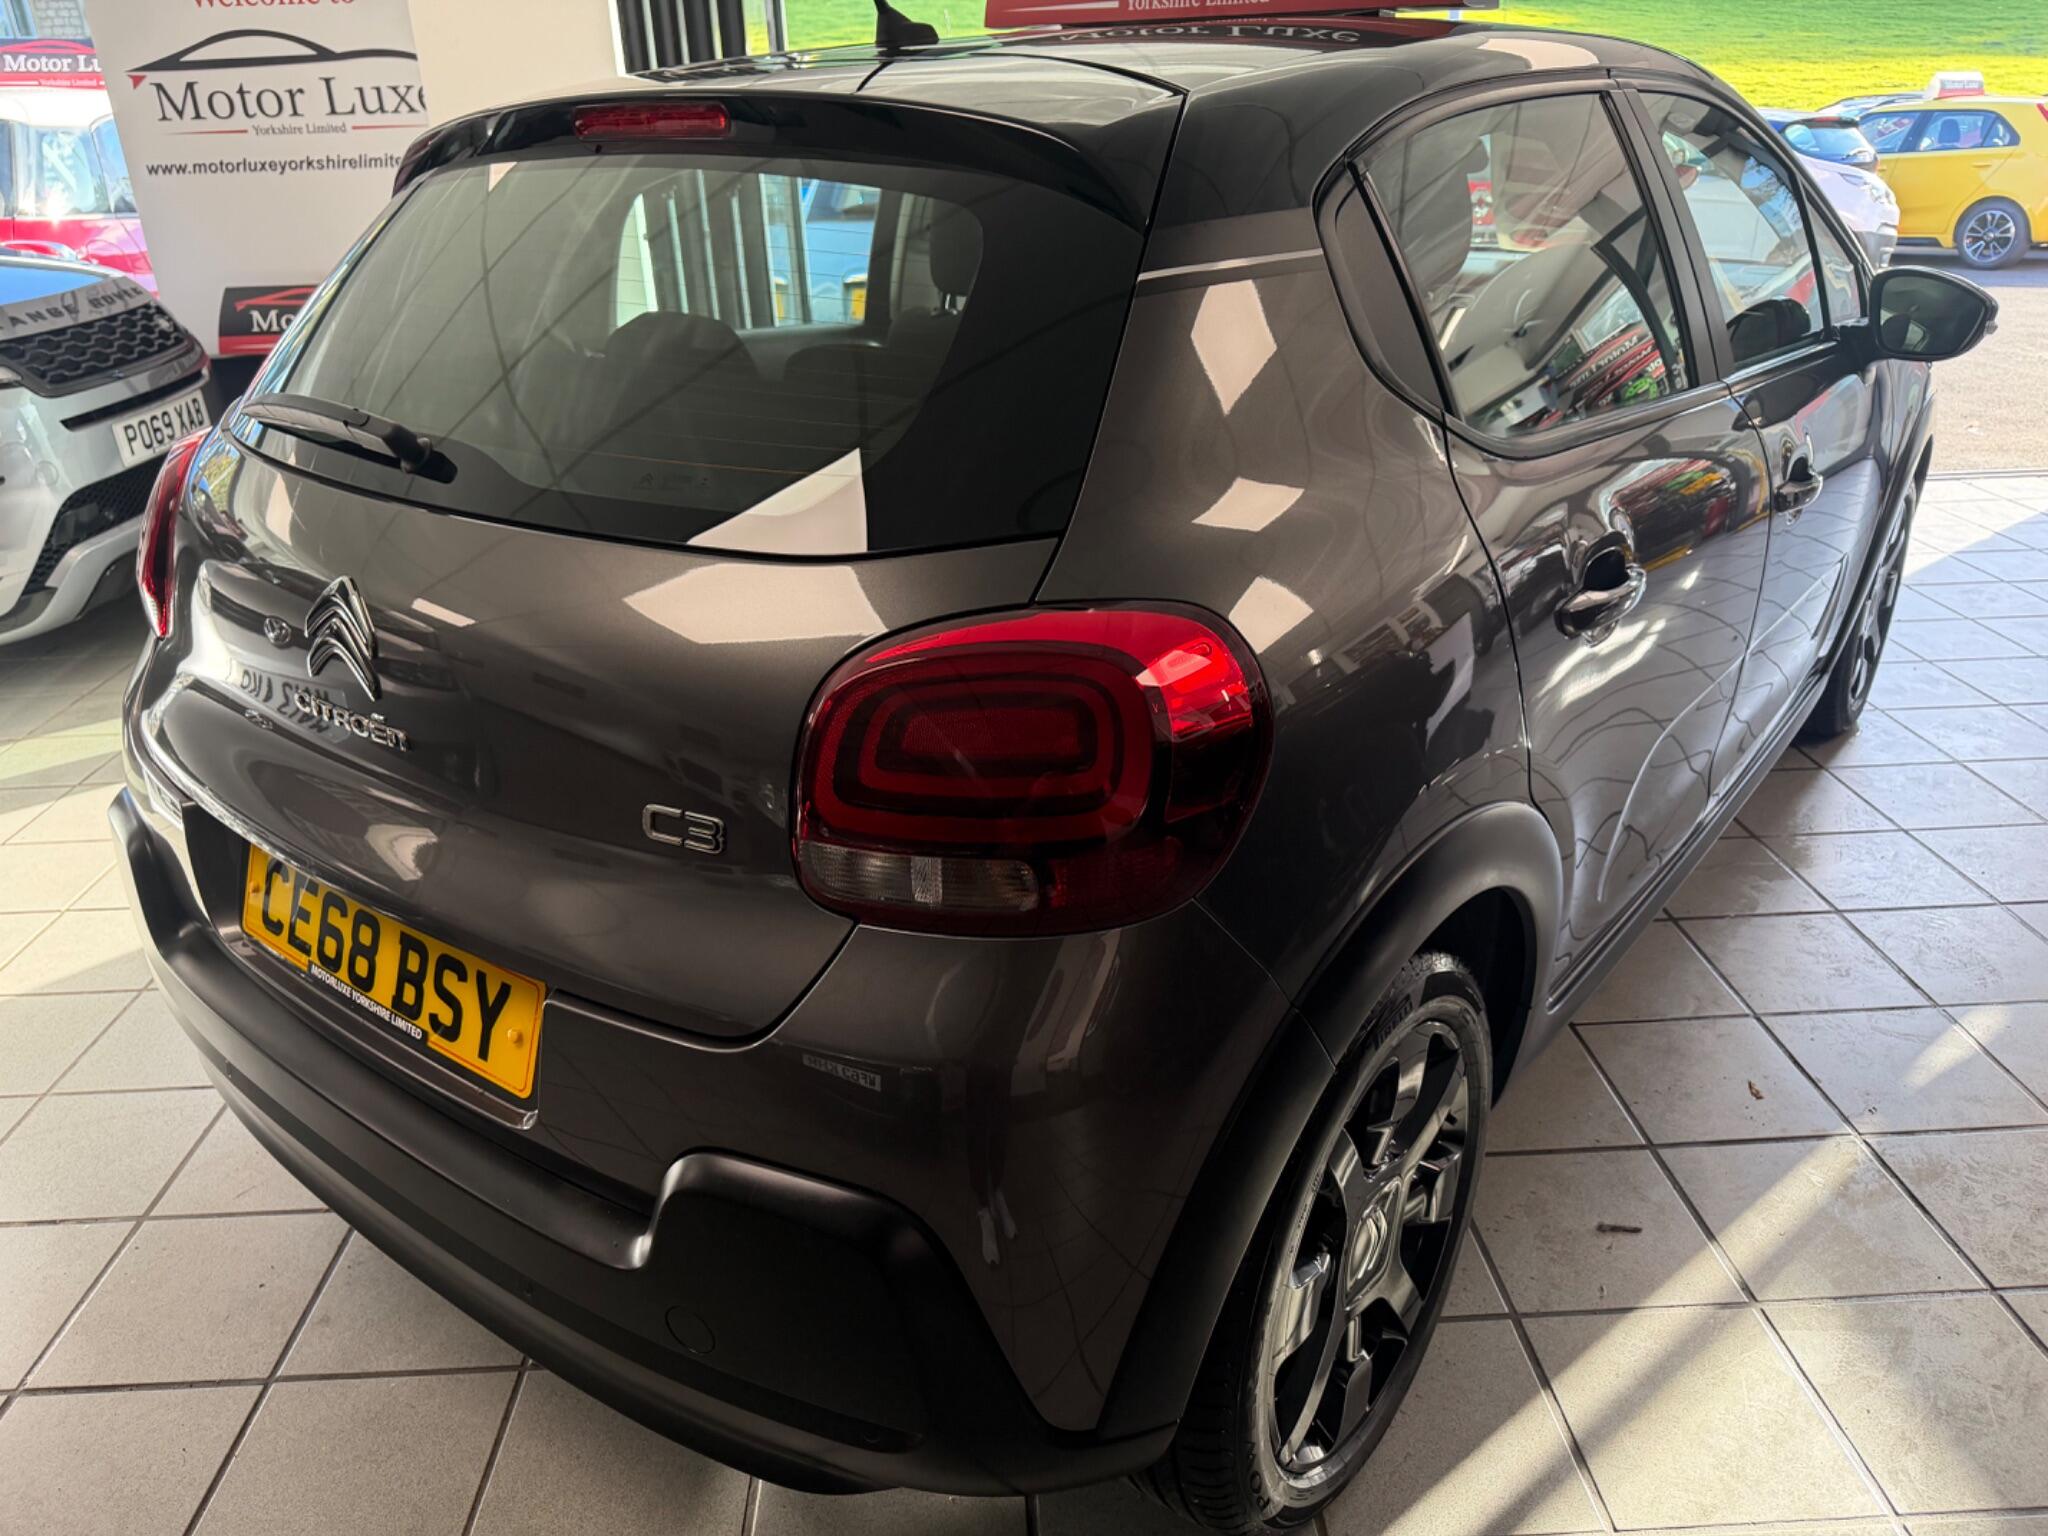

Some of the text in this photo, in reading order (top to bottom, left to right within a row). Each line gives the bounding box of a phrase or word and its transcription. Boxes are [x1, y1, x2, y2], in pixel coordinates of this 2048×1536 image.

[2, 54, 73, 72] Motor
[149, 80, 305, 122] Motor
[251, 121, 348, 136] Yorkshire Limited
[0, 302, 80, 331] ANGE
[123, 397, 205, 456] PO69 XAB
[294, 689, 408, 752] CITROËN
[642, 803, 725, 855] C3
[261, 858, 512, 1063] CE68 BSY
[311, 963, 423, 1040] MOTORLUXE YORKSHIRE LIMITED
